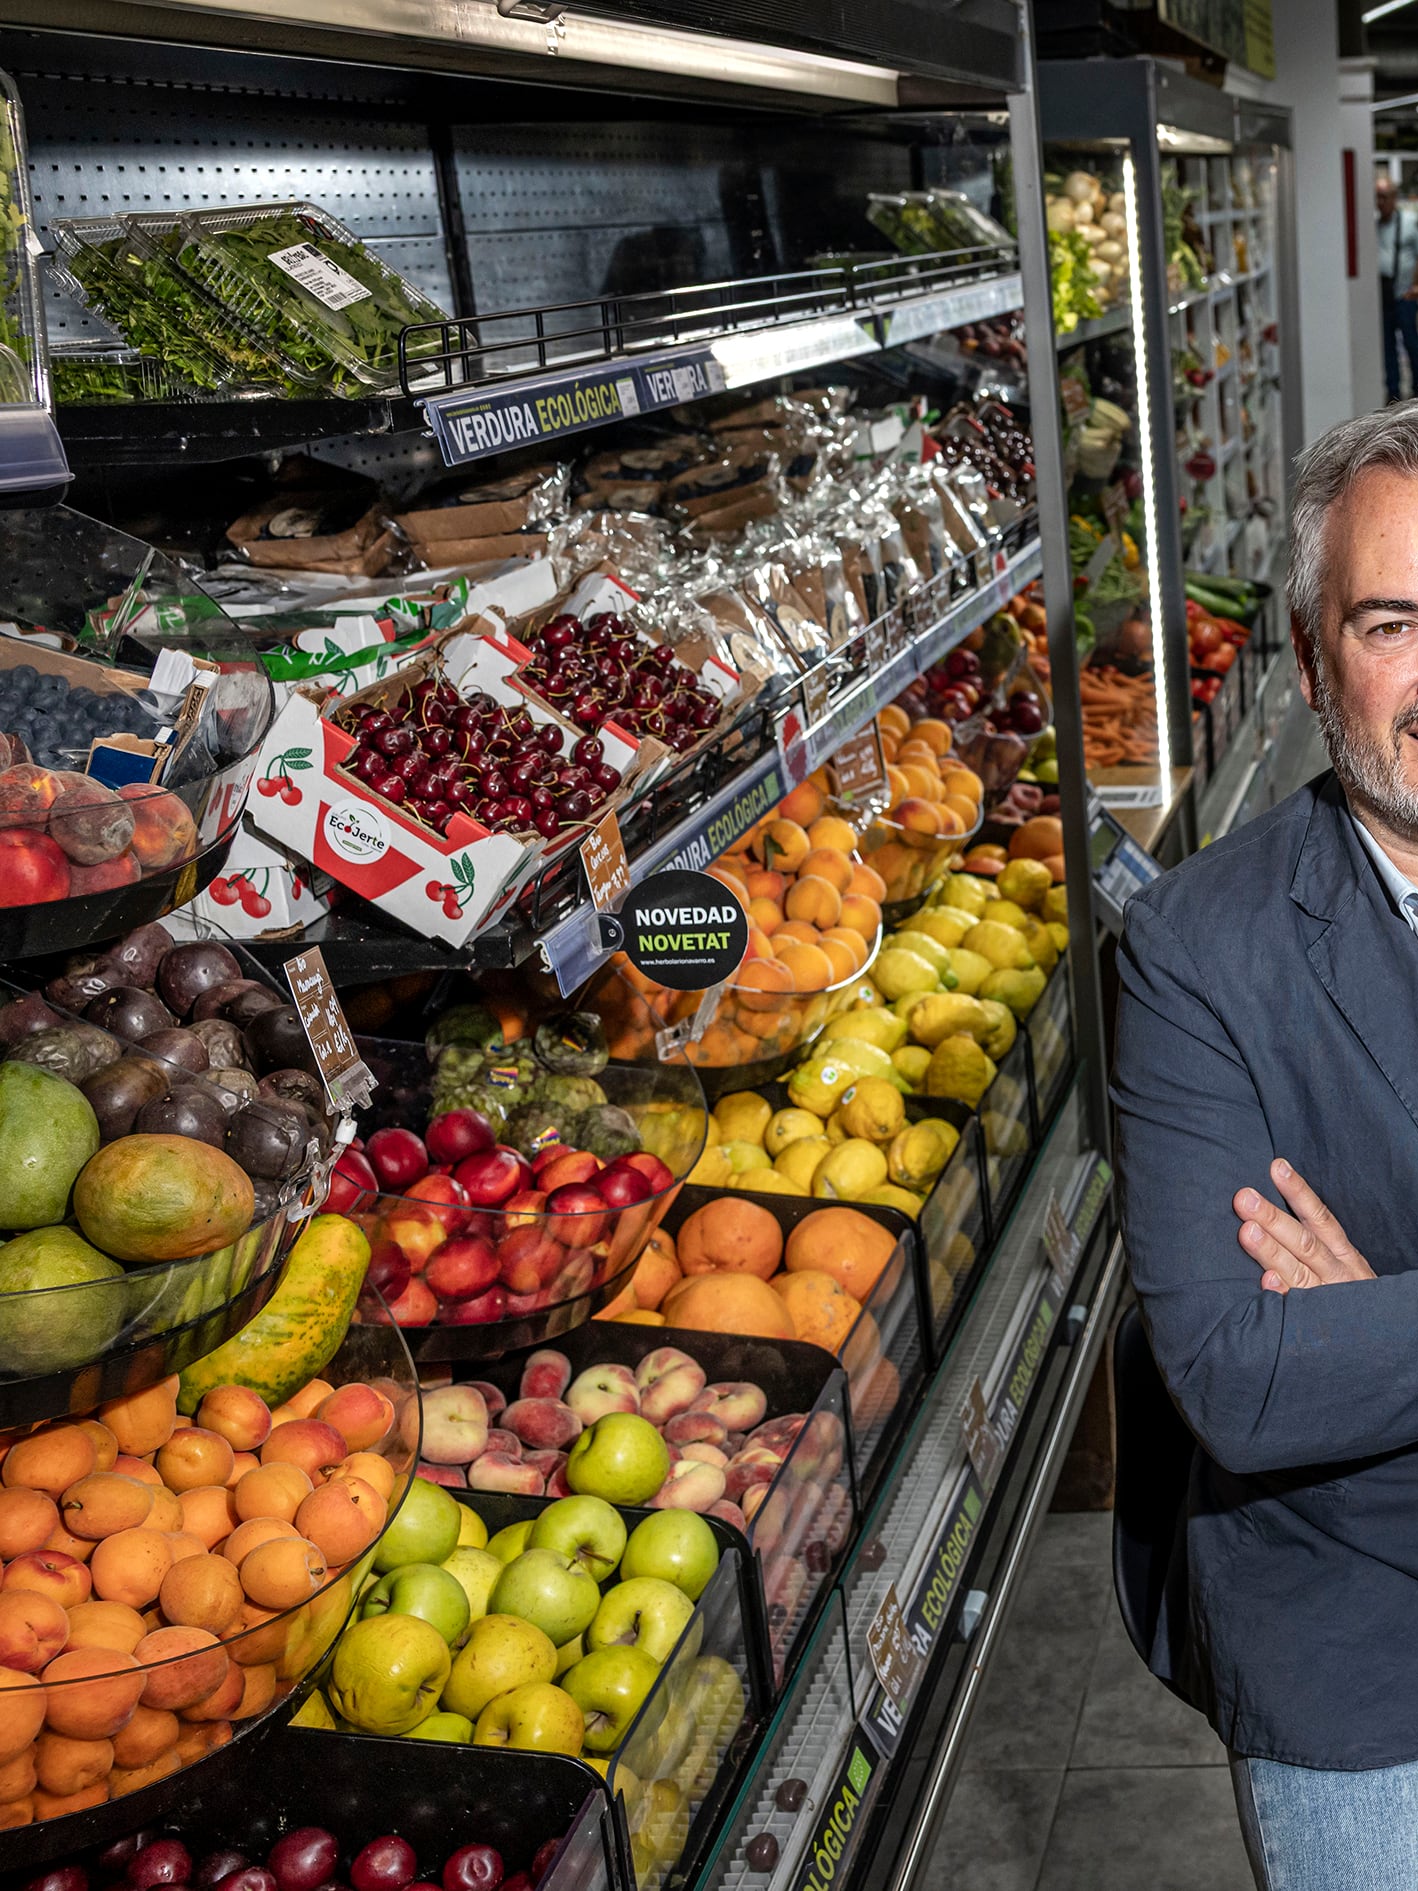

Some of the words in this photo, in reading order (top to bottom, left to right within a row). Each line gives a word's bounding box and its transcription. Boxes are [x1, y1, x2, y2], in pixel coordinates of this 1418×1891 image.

[448, 403, 540, 456] VERDURA
[536, 381, 622, 434] ECOLÓGICA
[708, 784, 769, 854] ECOLÓGICA
[635, 906, 738, 926] NOVEDAD
[639, 932, 730, 952] NOVETAT
[922, 1512, 973, 1631] ECOLÓGICA
[803, 1785, 860, 1891] LÓGICA
